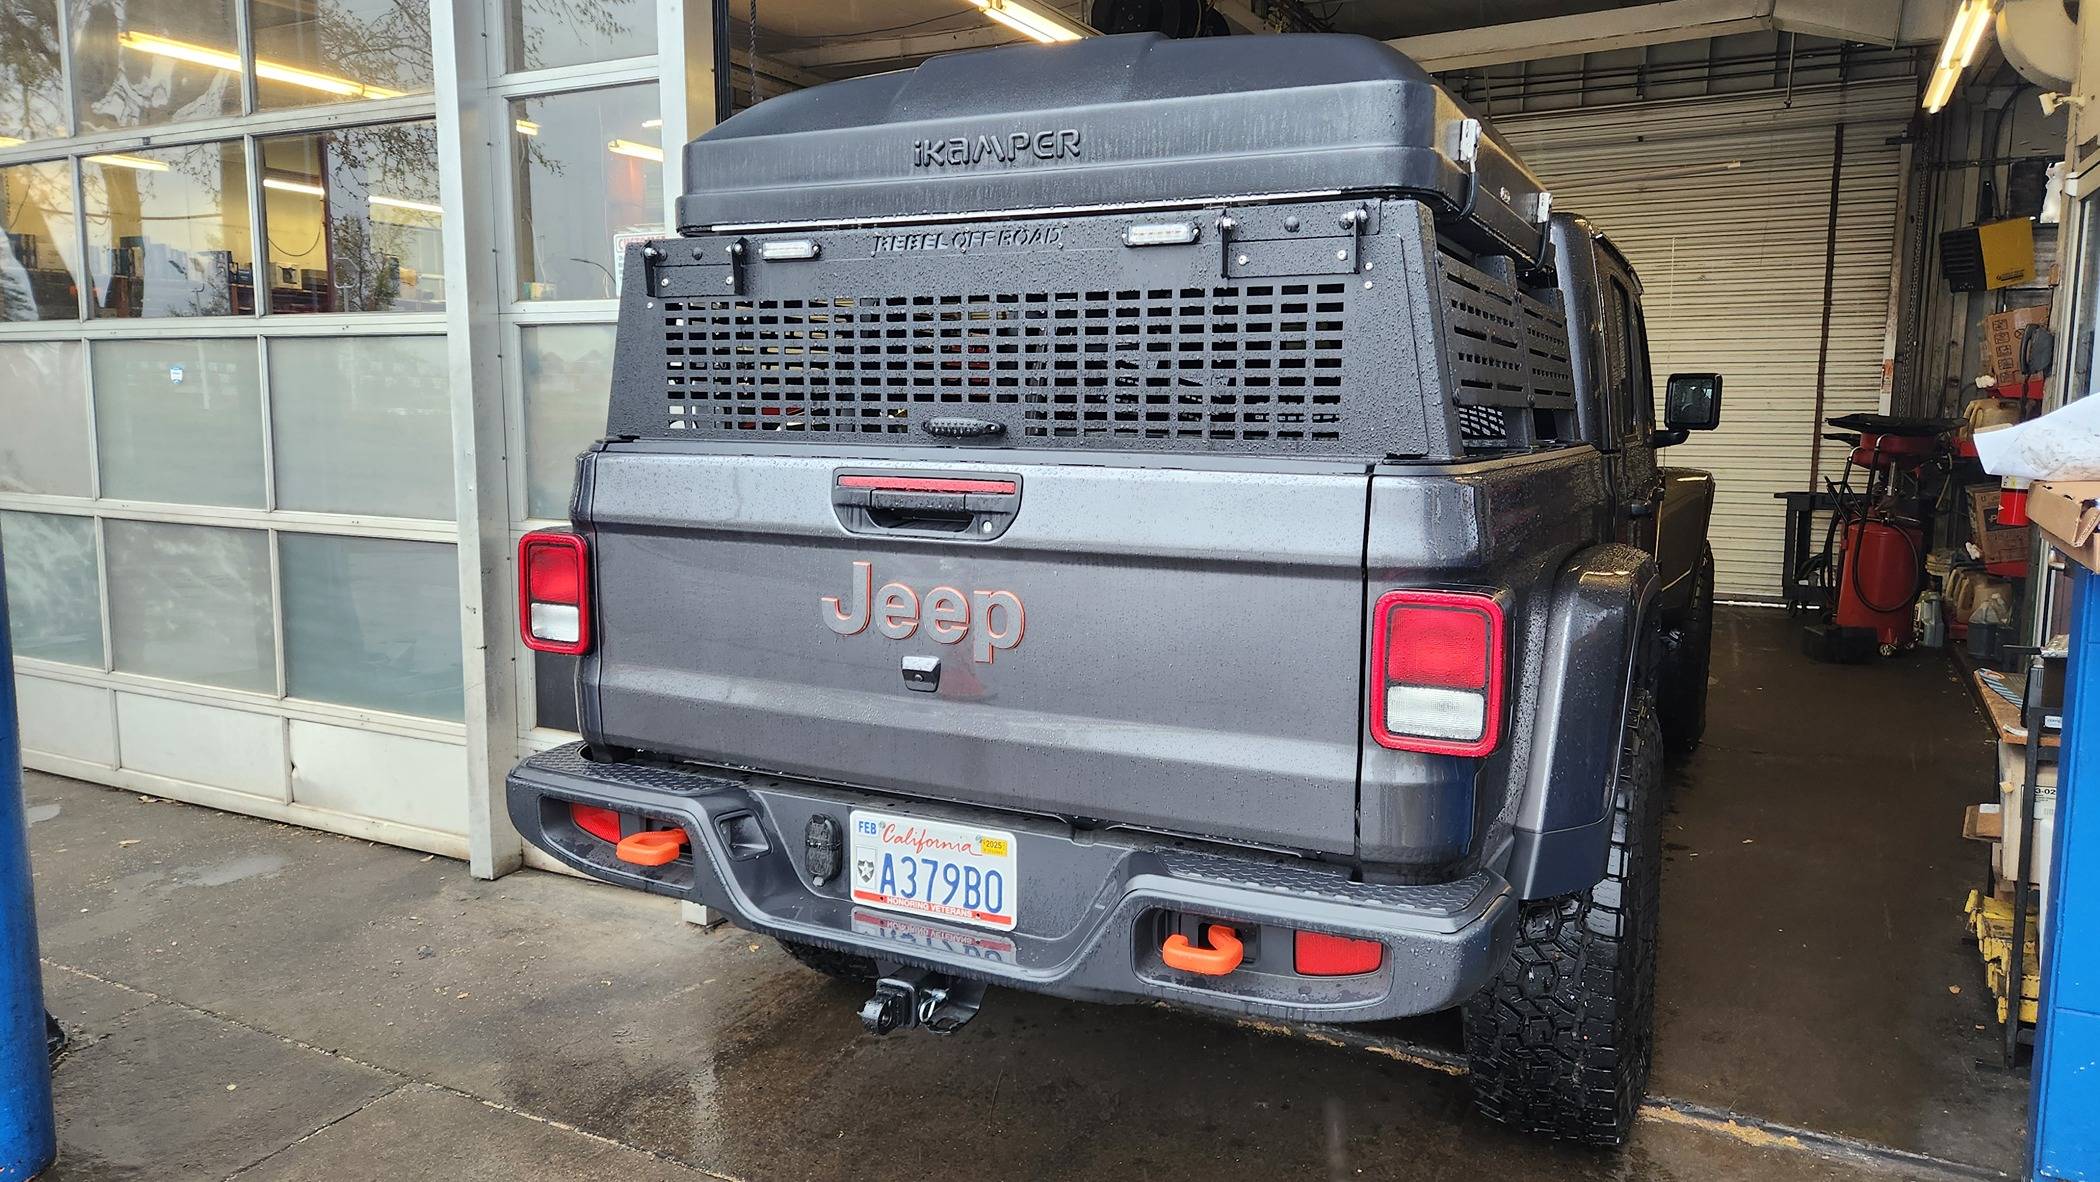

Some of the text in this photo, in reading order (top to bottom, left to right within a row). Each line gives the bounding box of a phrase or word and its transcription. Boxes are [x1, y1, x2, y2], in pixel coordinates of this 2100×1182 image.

[873, 227, 1064, 252] REBEL OFF ROAD
[820, 560, 1026, 664] Jeep
[858, 820, 877, 835] FEB
[882, 823, 982, 856] California
[985, 839, 1003, 849] 2025
[887, 896, 973, 917] HONORING VETERANS
